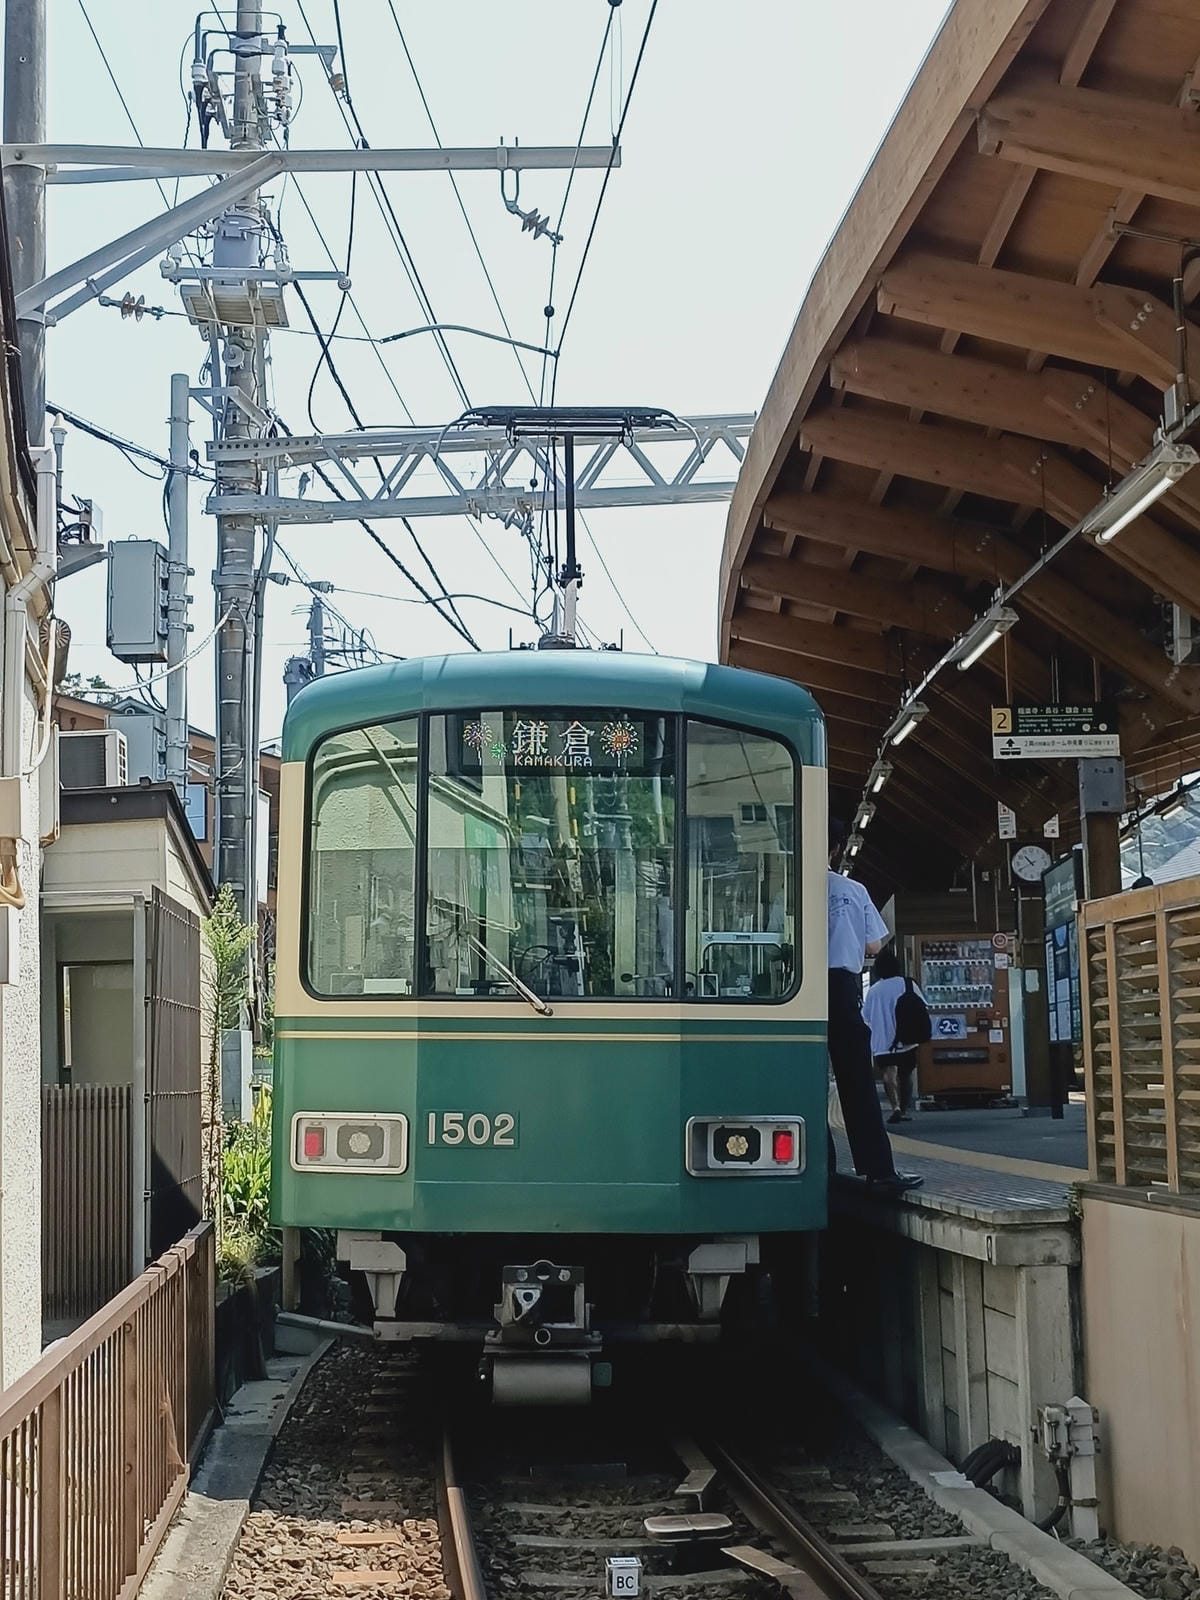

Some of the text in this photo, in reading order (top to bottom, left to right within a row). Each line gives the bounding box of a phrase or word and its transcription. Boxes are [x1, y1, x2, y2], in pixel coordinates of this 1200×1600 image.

[996, 712, 1007, 729] 2
[512, 720, 595, 756] 鎌倉
[514, 755, 593, 767] KAMAKURA
[428, 1112, 515, 1145] 1502
[616, 1575, 634, 1589] BC
